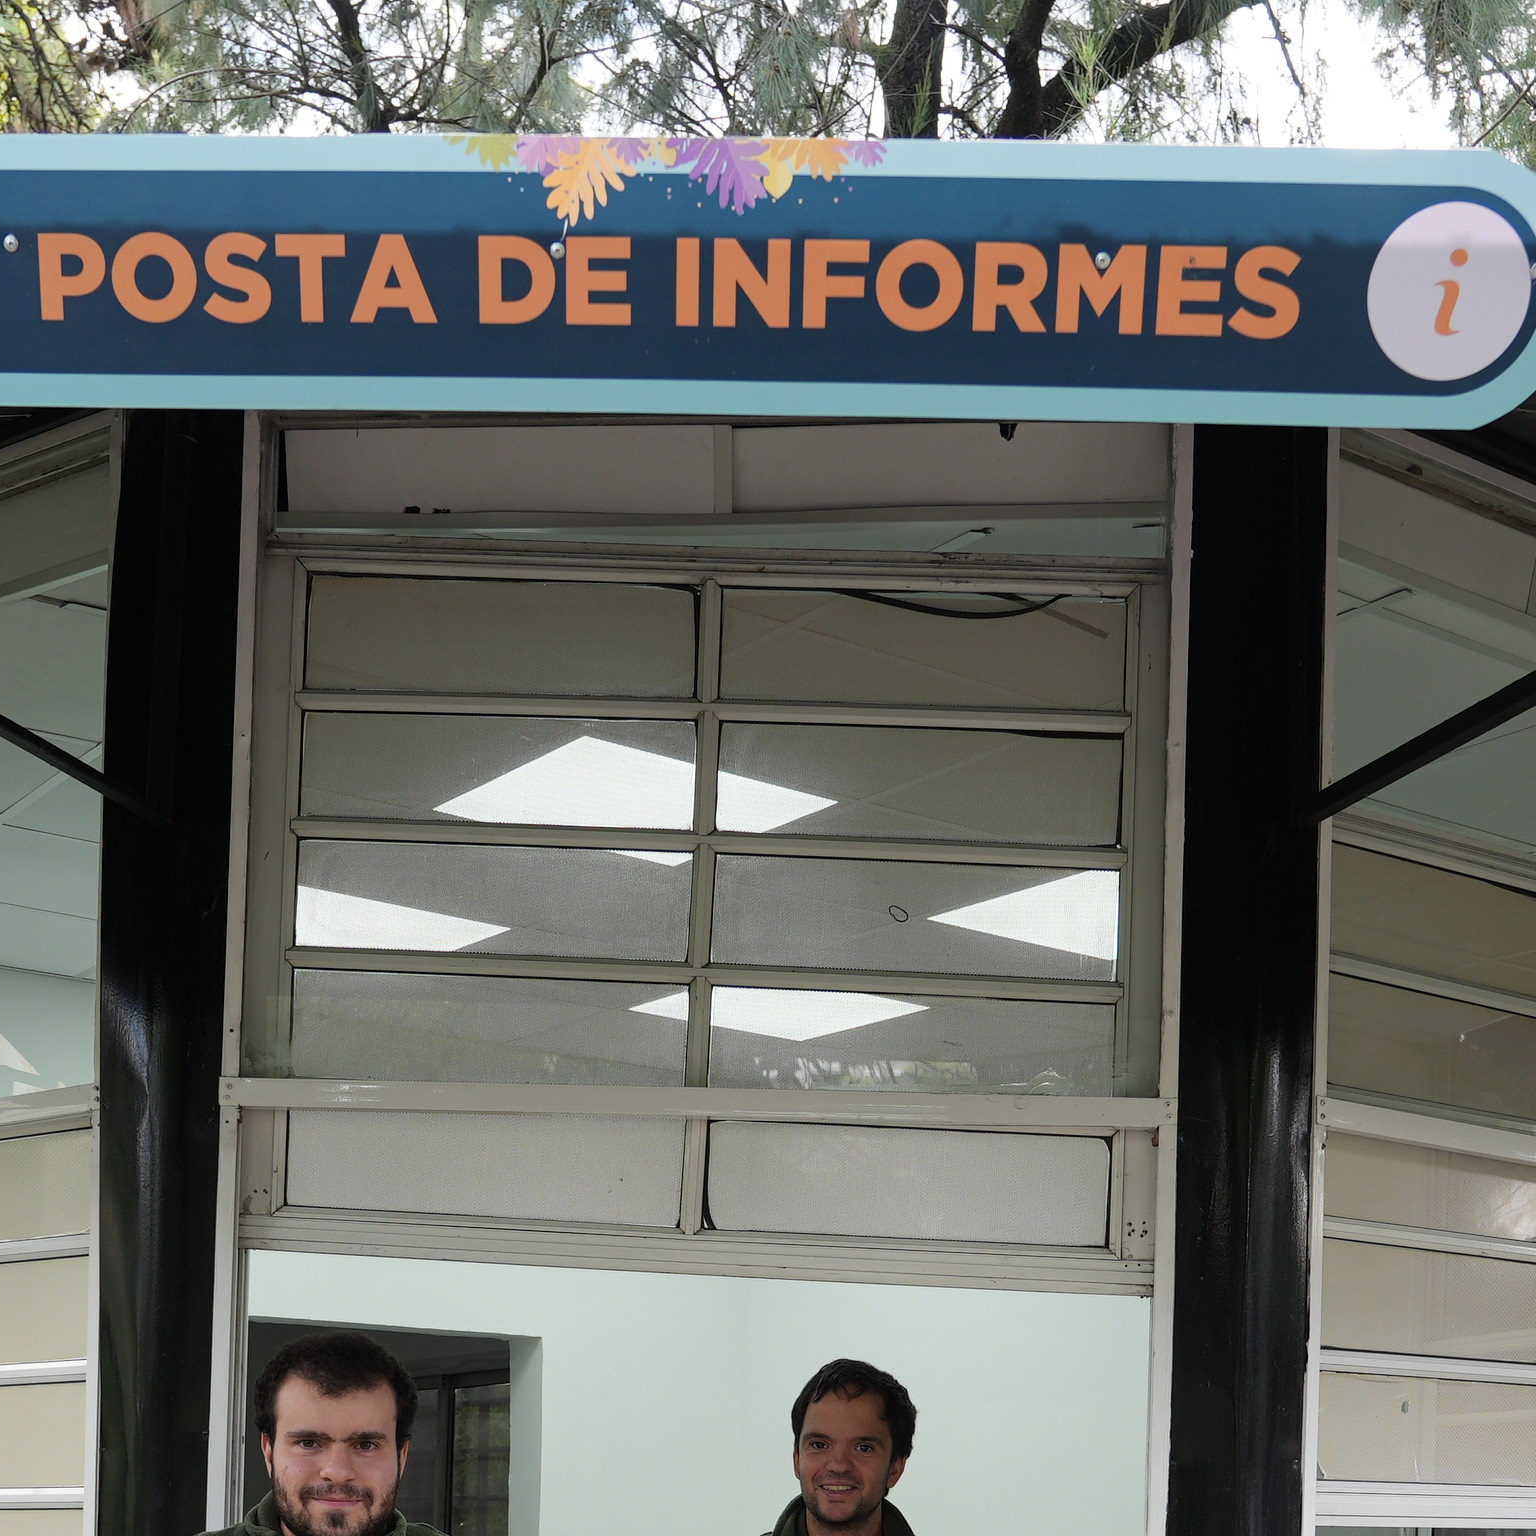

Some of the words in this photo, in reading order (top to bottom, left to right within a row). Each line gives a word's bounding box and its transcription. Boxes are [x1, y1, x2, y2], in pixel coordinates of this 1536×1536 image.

[38, 231, 438, 324] POSTA
[478, 235, 632, 326] DE
[676, 237, 1302, 339] INFORMES
